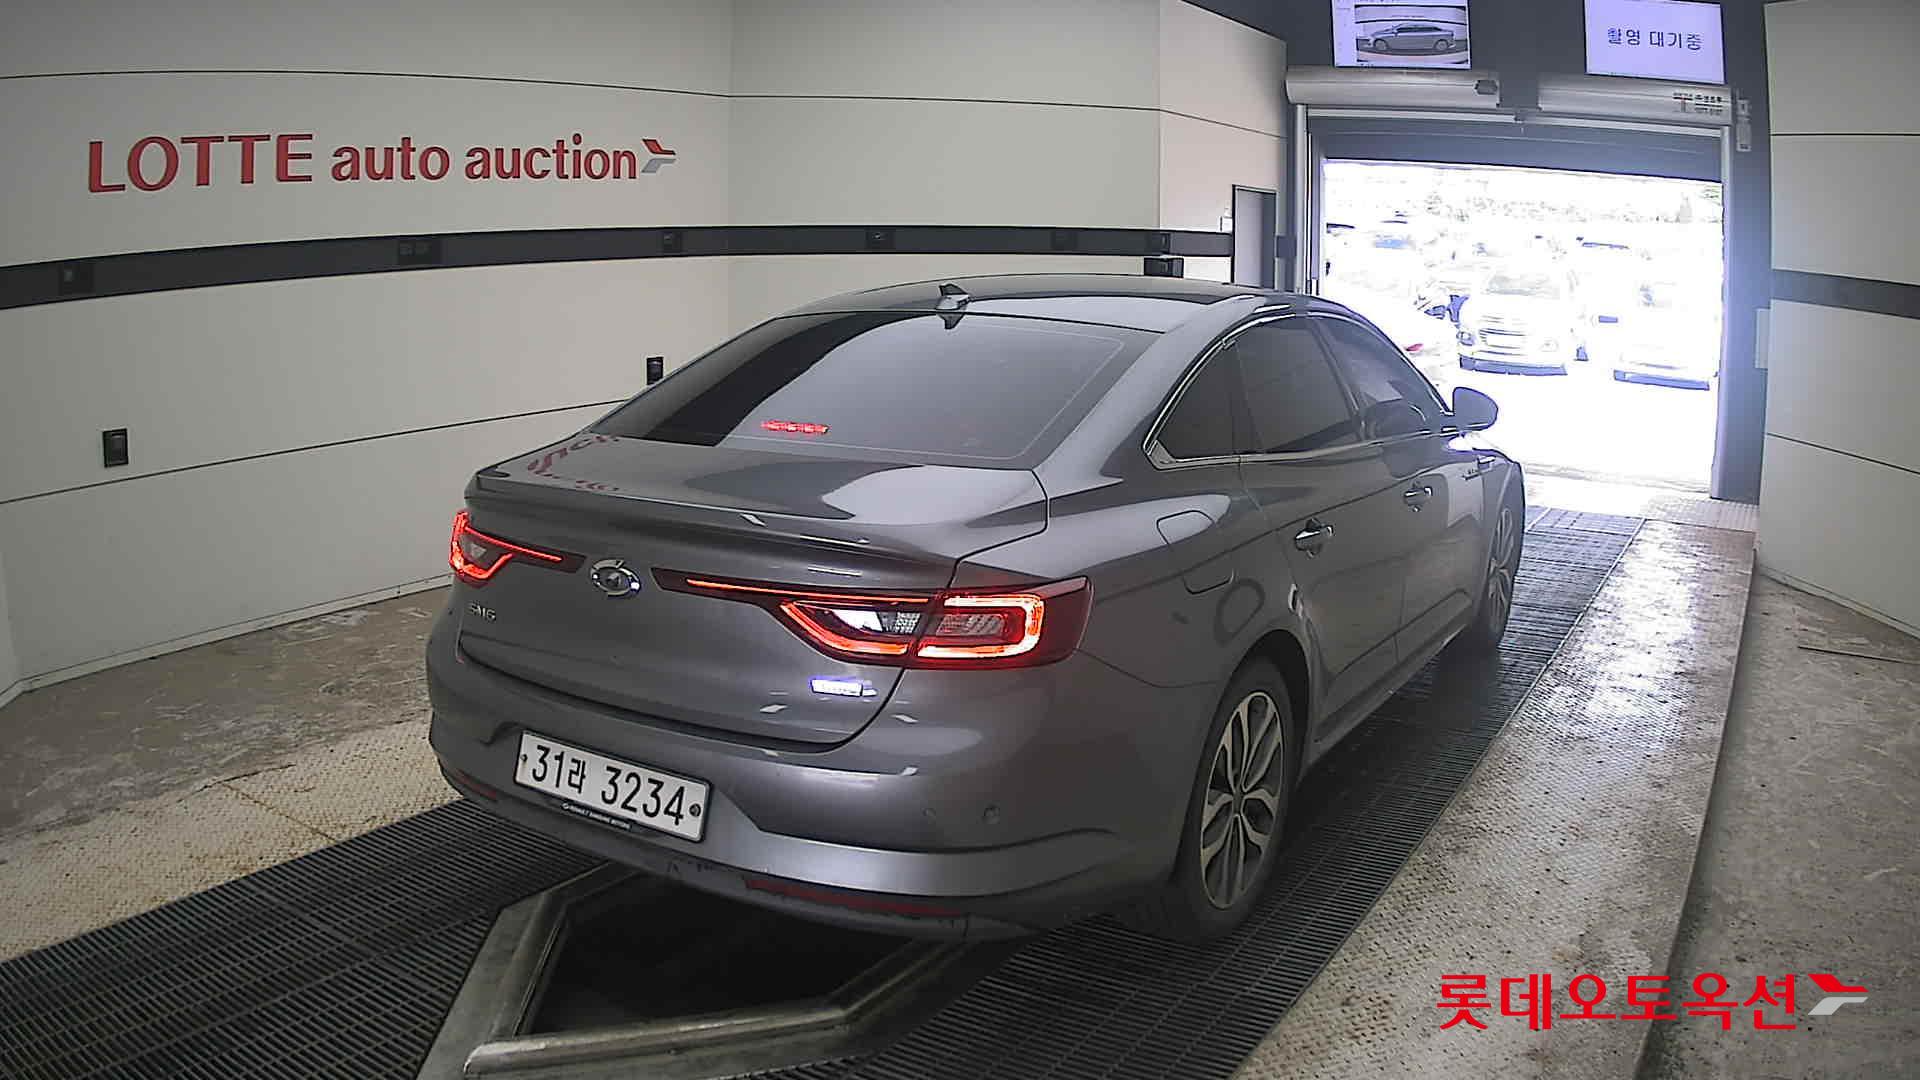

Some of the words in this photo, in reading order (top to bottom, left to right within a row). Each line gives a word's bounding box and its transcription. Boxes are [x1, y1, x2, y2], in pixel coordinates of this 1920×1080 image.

[1608, 28, 1641, 46] 촬영
[1649, 31, 1701, 51] 대기중
[88, 133, 313, 193] LOTTE
[331, 136, 450, 181] auto
[464, 132, 637, 180] auction
[532, 744, 587, 794] 31라
[601, 765, 686, 826] 3234
